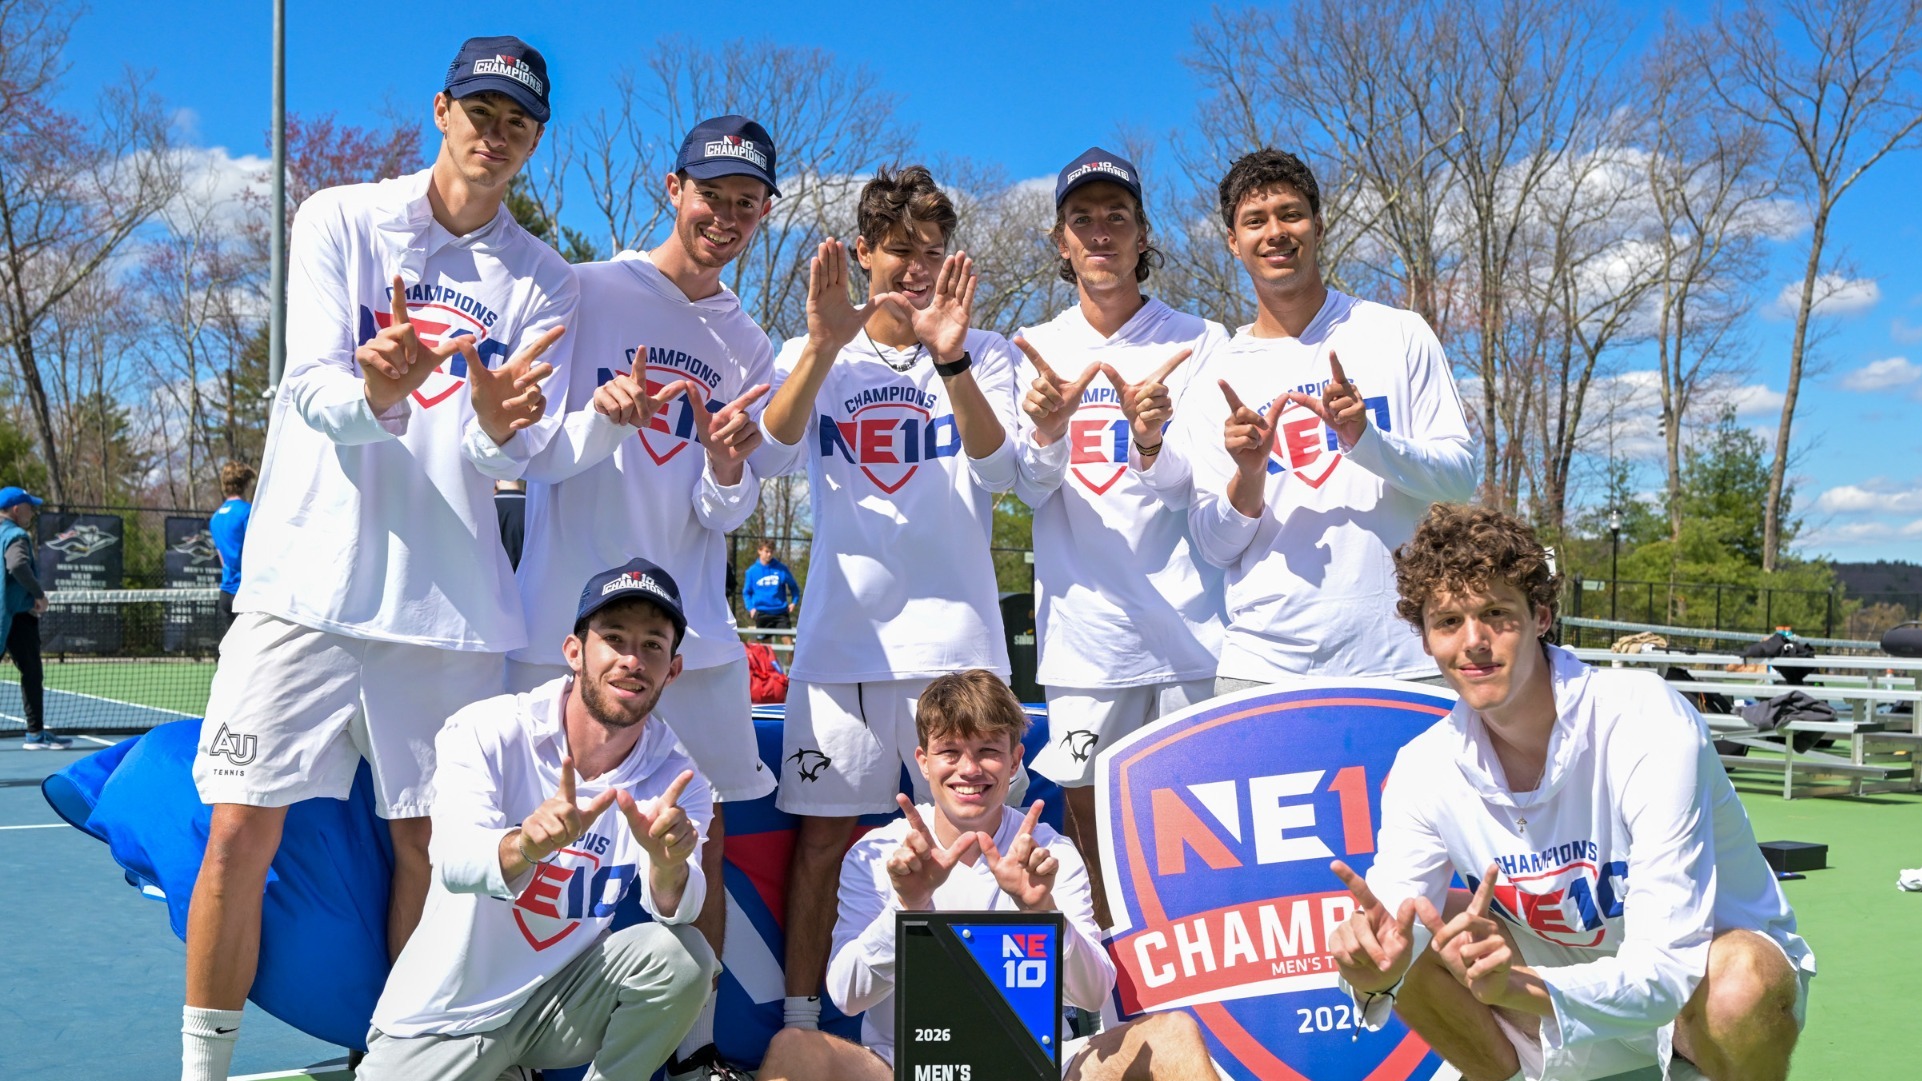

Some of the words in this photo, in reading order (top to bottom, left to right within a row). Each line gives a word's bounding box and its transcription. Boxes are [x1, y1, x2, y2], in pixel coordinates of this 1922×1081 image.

[495, 54, 530, 72] NE10
[476, 62, 542, 94] CHAMPIONS
[707, 144, 766, 168] CHAMPIONS
[723, 135, 754, 150] NE10
[386, 284, 498, 327] CAMPIONS
[625, 347, 722, 389] CAMPIONS
[844, 386, 938, 414] CHAMPIONS
[819, 413, 962, 465] NE10
[603, 579, 671, 601] CHAMPIONS
[621, 571, 655, 585] NE10
[209, 721, 258, 766] AU
[213, 768, 245, 777] TENNIS
[1151, 765, 1390, 877] NE1
[1494, 839, 1598, 875] CHAMPIONS
[491, 861, 636, 920] E10
[1002, 933, 1048, 958] NE
[1133, 895, 1364, 989] CHAMP
[1002, 959, 1047, 988] 10
[1271, 956, 1322, 976] MEN'S
[914, 1028, 951, 1042] 2026
[914, 1063, 971, 1081] MEN'S
